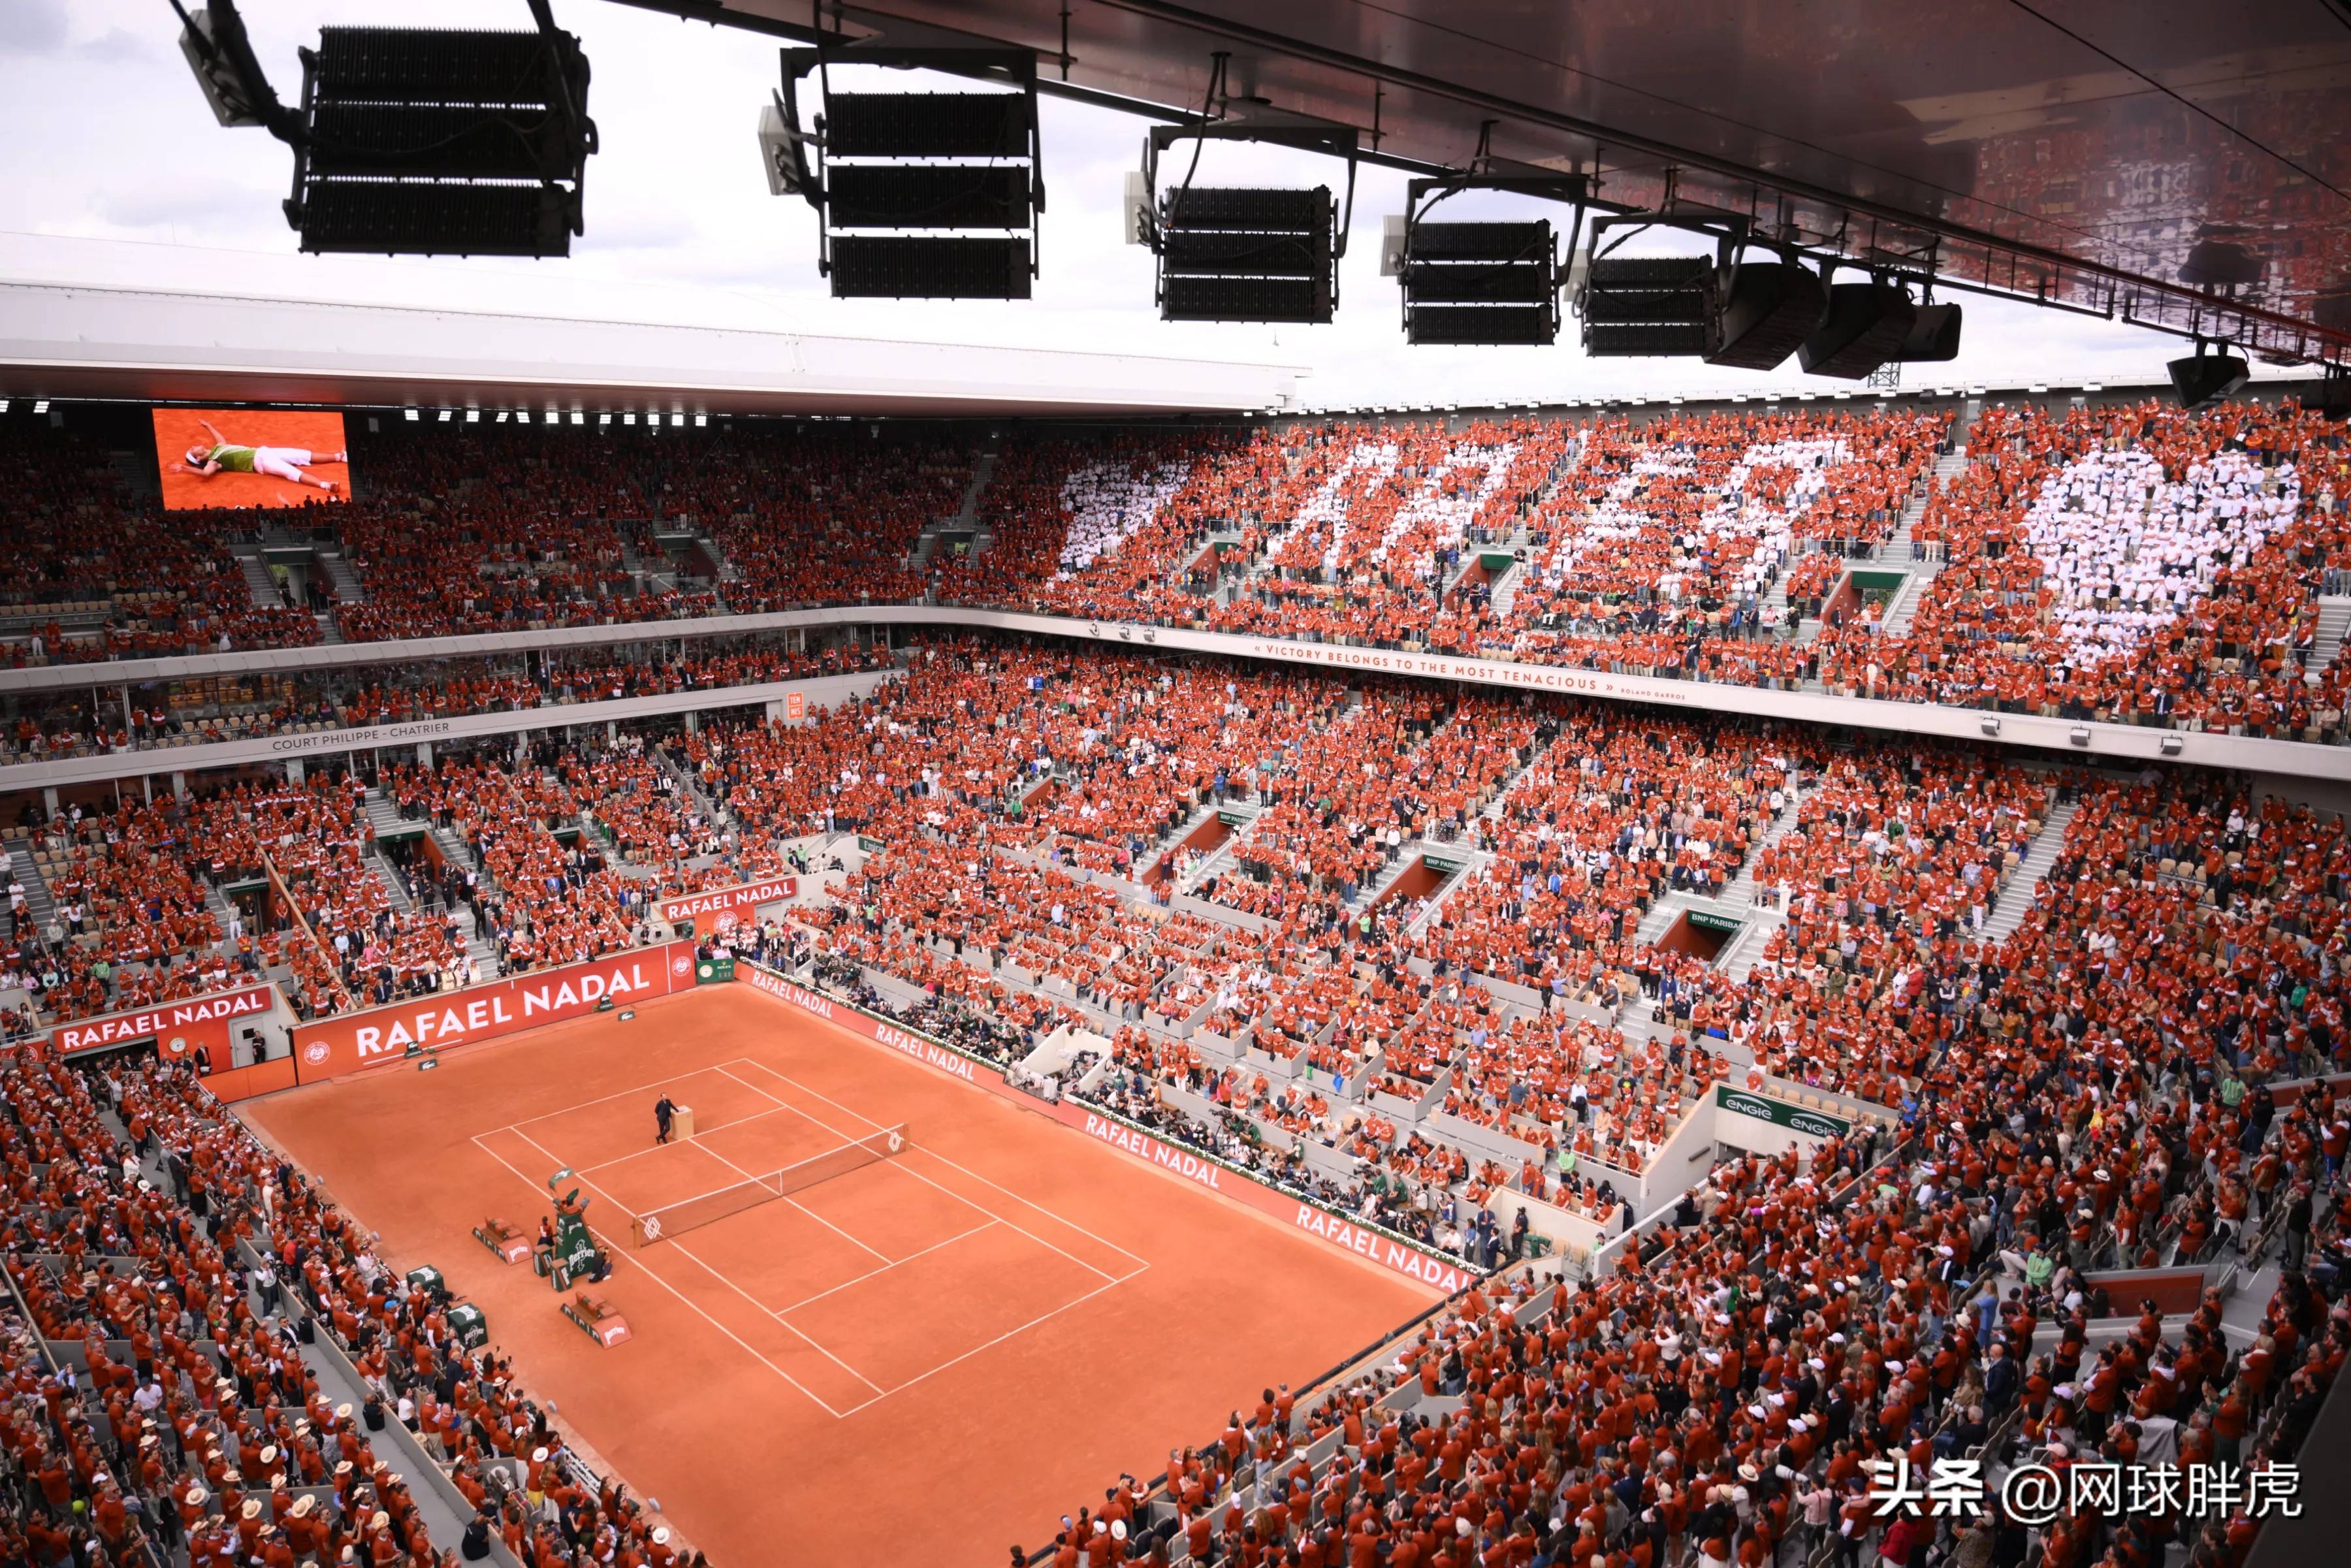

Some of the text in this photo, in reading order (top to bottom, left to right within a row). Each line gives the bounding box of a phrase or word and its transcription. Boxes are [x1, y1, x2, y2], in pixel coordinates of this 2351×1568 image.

[1266, 645, 1321, 660] VICTORY
[1328, 652, 1388, 667] BELONGS
[1396, 659, 1412, 669] TO
[1420, 662, 1447, 673] THE
[1455, 667, 1495, 679] MOST
[1503, 671, 1596, 690] TENACIOUS
[1621, 688, 1686, 701] ROLAND GARROS
[272, 737, 318, 750] COURT
[323, 730, 379, 745] PHILIPPE
[390, 723, 449, 737] CHATRIER
[668, 895, 731, 920] RAFAEL
[736, 882, 792, 905] NADAL
[1692, 914, 1708, 922] BNP
[356, 964, 650, 1057] RAFAEL NADAL
[752, 971, 833, 1019] RAFAEL NADAL
[63, 993, 263, 1049] RAFAEL NADAL
[875, 1023, 974, 1081] RAFAEL NADAL
[1085, 1114, 1219, 1188] RAFAEL NADAL
[1296, 1205, 1380, 1259] RAFAEL
[568, 1248, 596, 1272] Perrier
